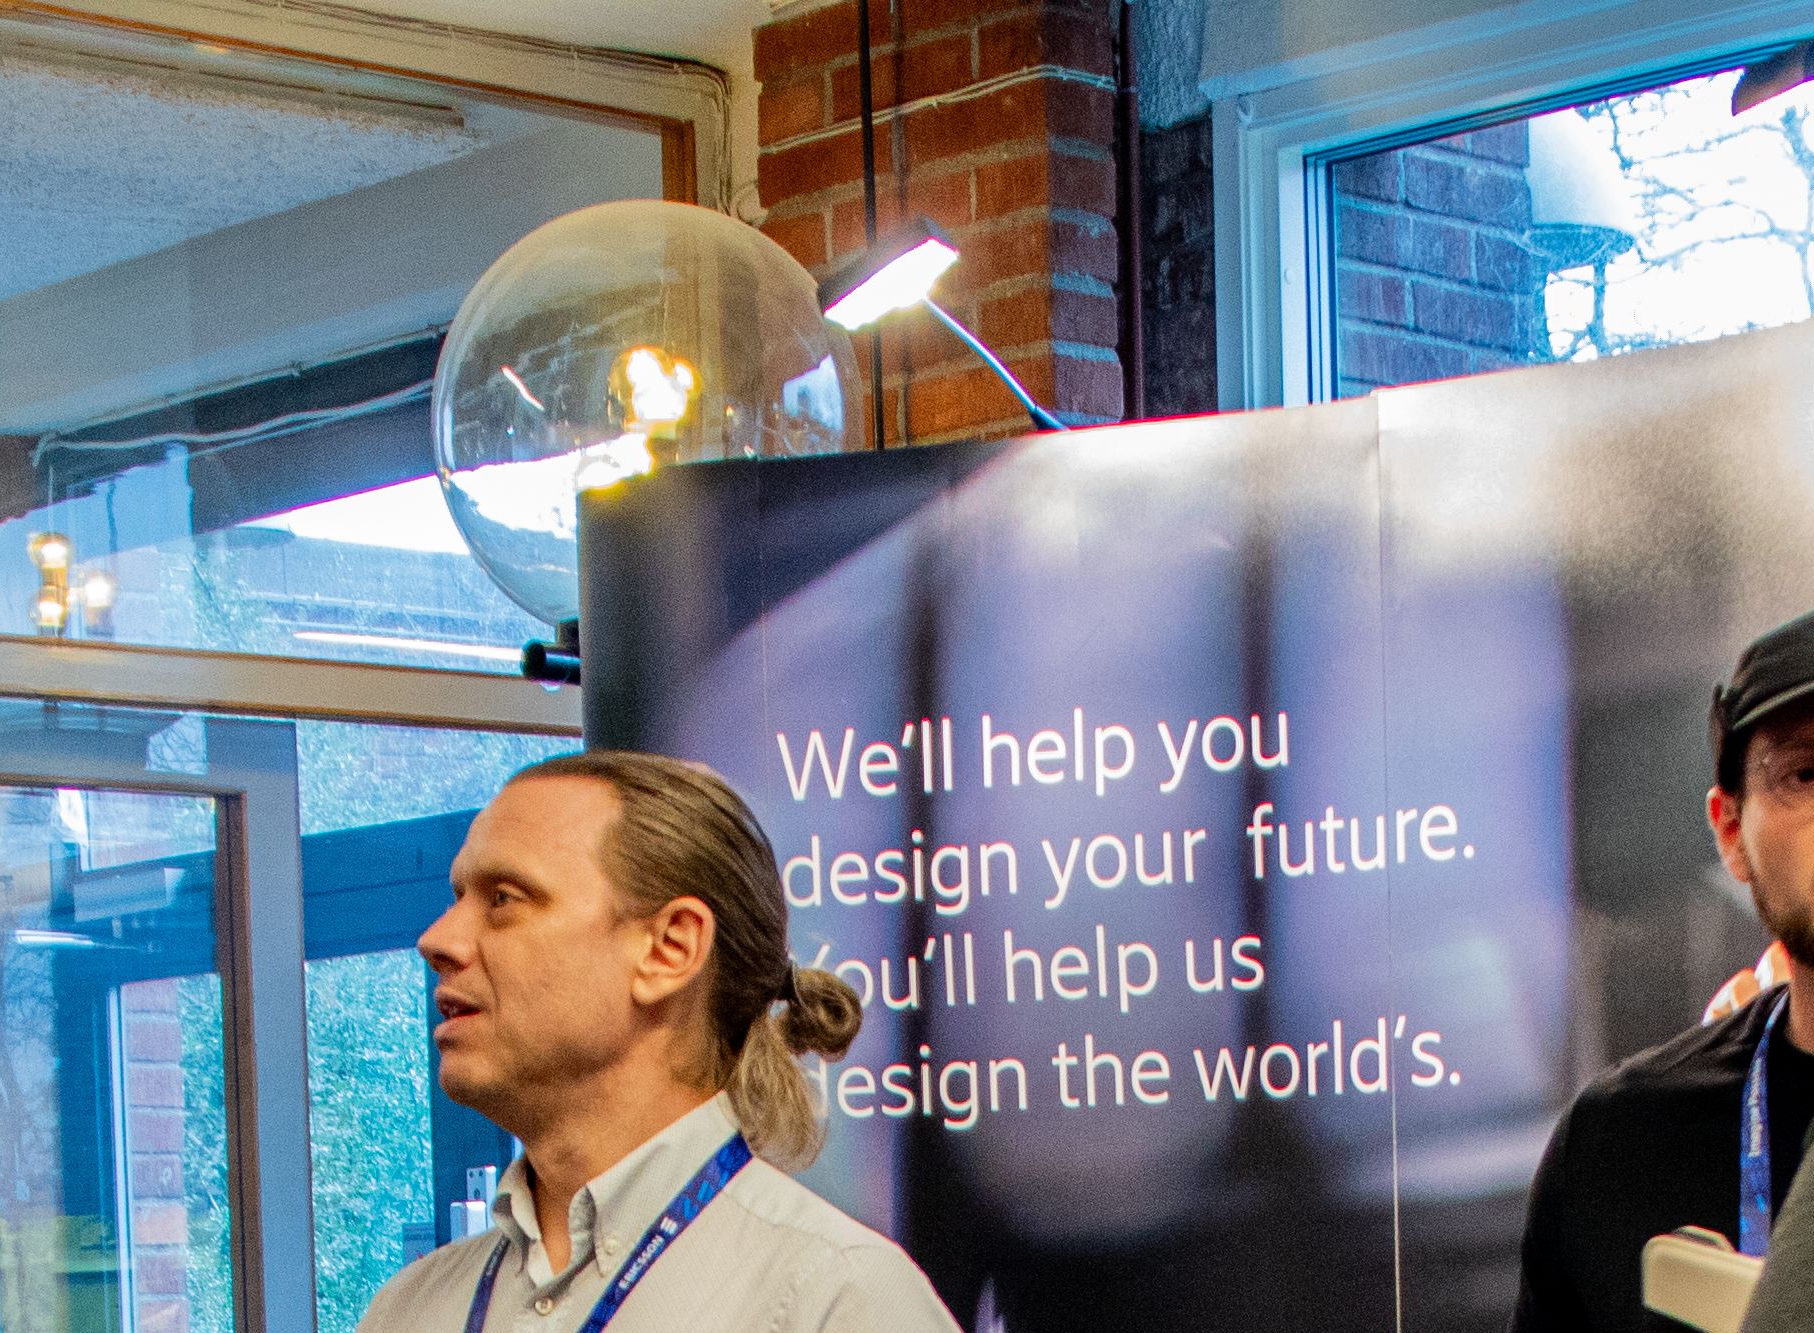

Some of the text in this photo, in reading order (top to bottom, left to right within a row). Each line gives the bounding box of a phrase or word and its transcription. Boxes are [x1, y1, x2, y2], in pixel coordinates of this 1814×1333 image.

[775, 708, 1291, 801] We'll help you
[782, 802, 1477, 917] design your future.
[1004, 924, 1159, 1013] help
[1185, 932, 1266, 995] us
[1052, 1034, 1171, 1109] the
[1193, 1015, 1463, 1102] world's.
[617, 1233, 665, 1290] ERICSSON
